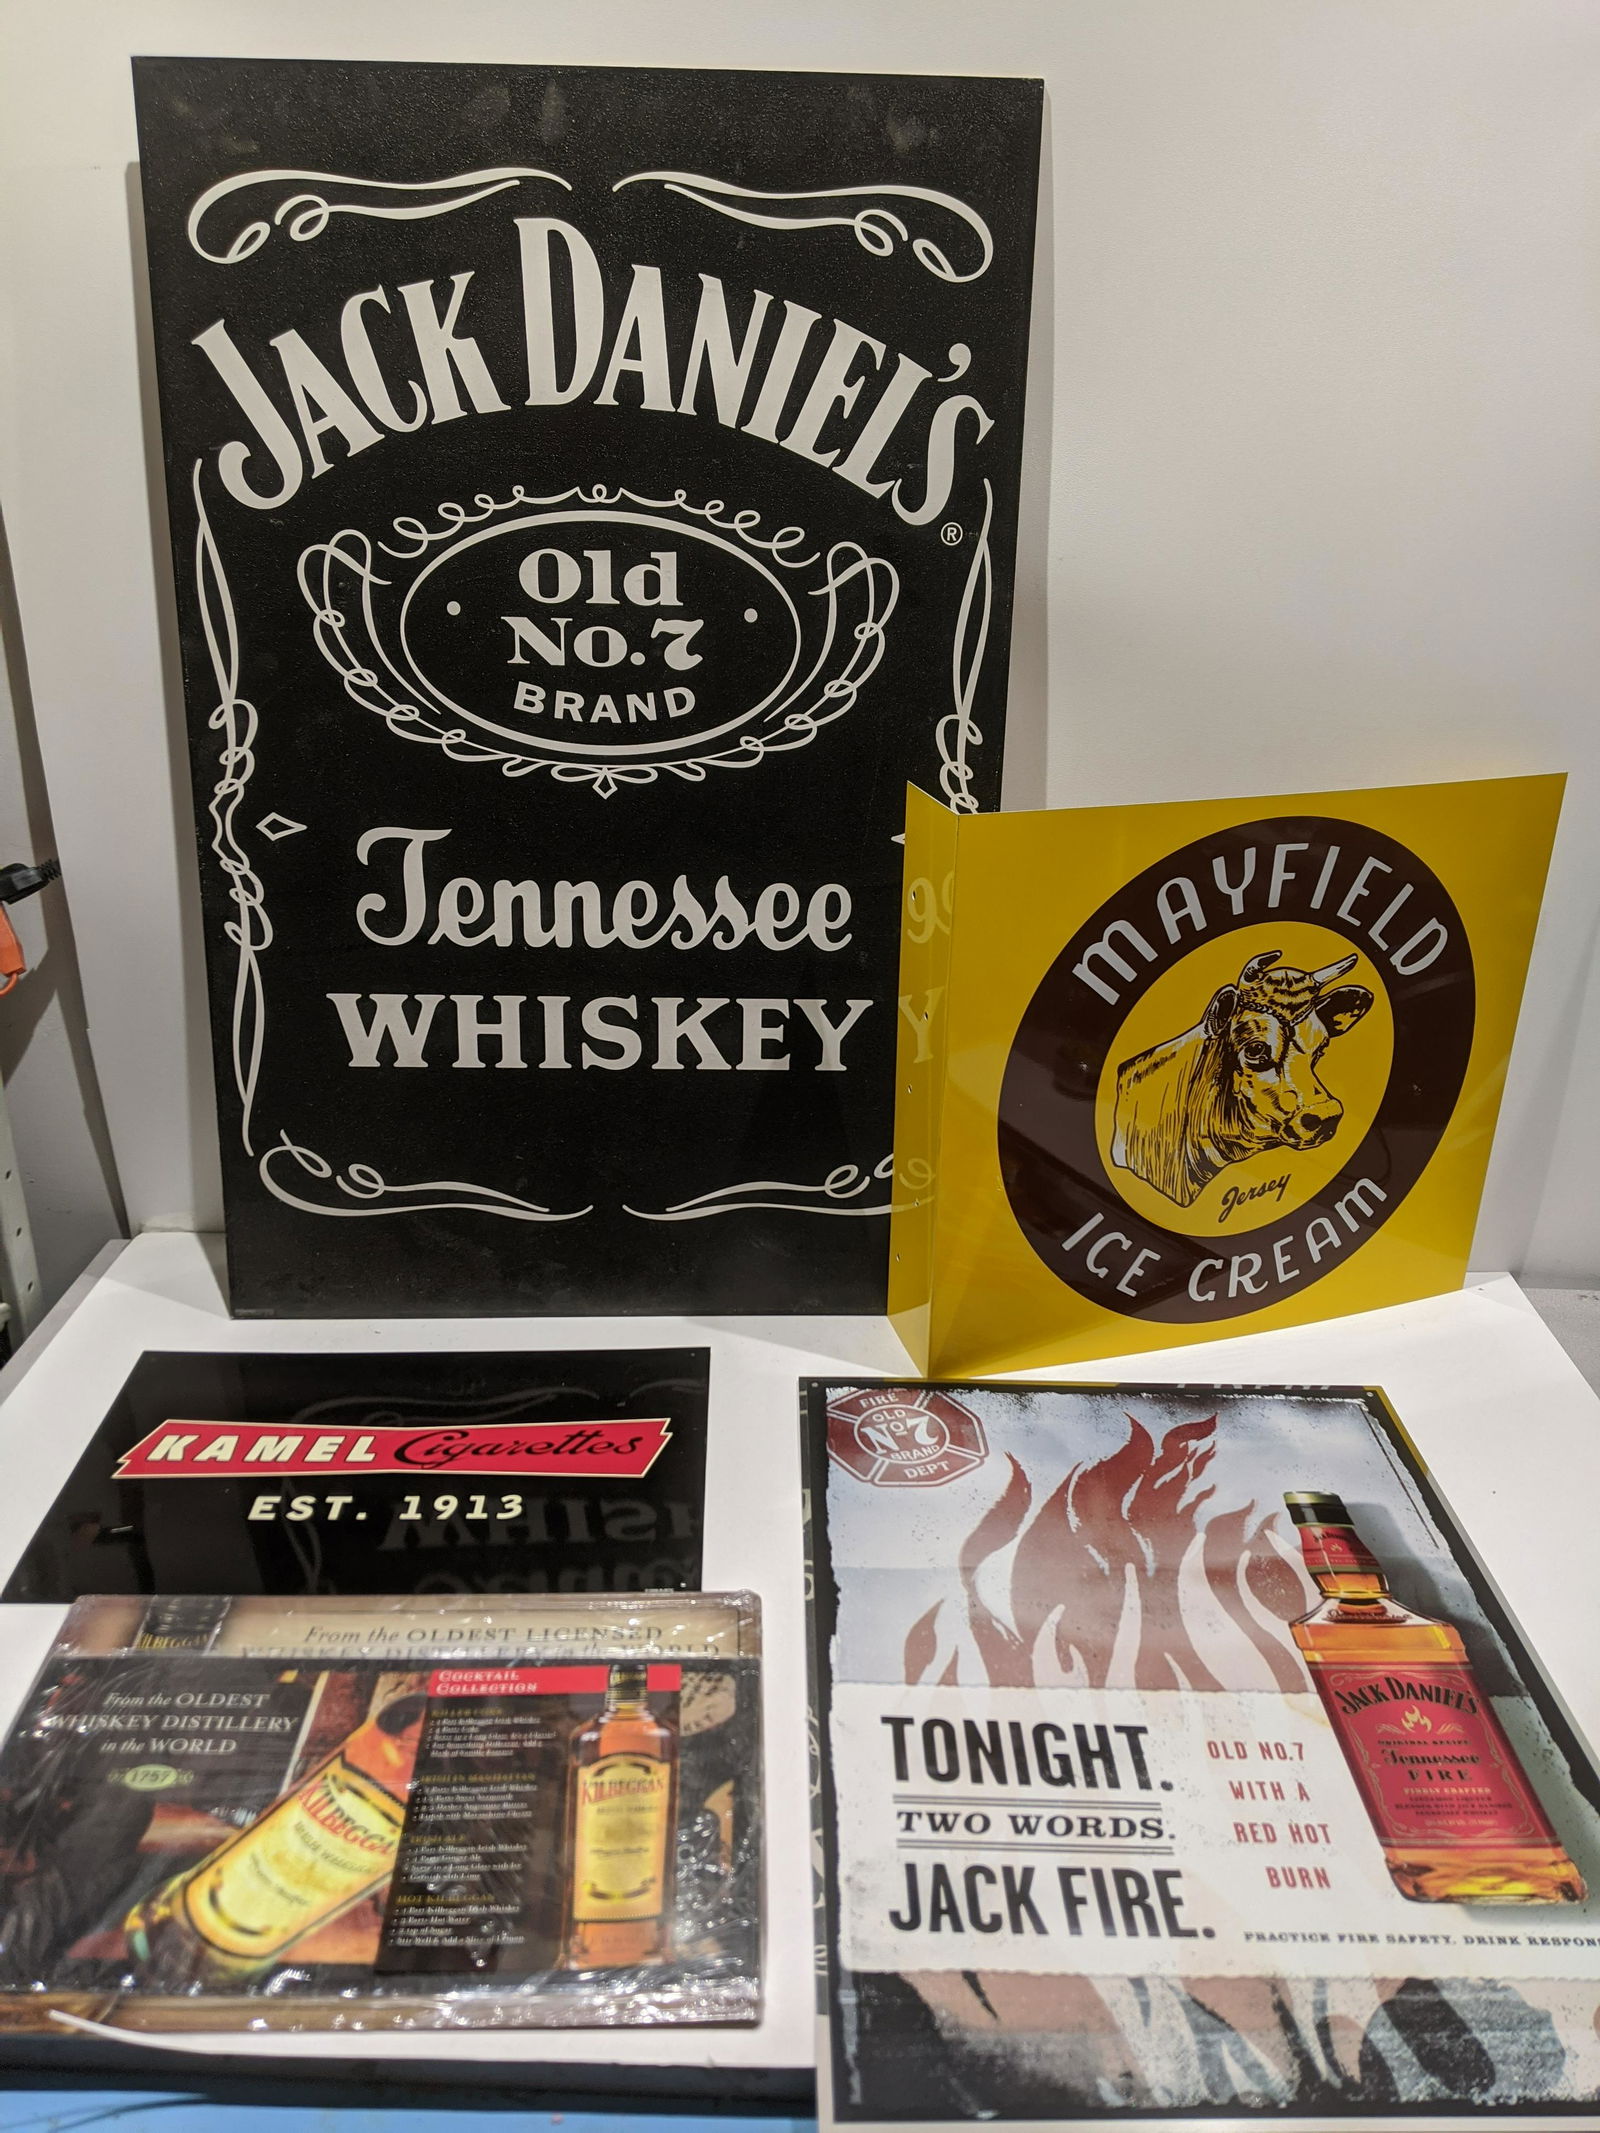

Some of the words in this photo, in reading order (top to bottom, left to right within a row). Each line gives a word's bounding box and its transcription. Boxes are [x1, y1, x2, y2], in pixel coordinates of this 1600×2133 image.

[191, 271, 511, 510] JACK
[513, 217, 994, 525] DANIEL'S
[519, 549, 679, 606] Old
[513, 681, 696, 725] BRAND
[356, 827, 852, 951] Tennessee
[1072, 842, 1449, 1005] MAYFIELD
[326, 993, 873, 1072] WHISKEY
[1218, 1172, 1294, 1223] Jersey
[1061, 1212, 1161, 1297] ICE
[1188, 1177, 1388, 1301] CREAM
[859, 1392, 899, 1408] FIRE
[872, 1409, 906, 1422] OLD
[145, 1434, 377, 1463] KAMEL
[393, 1430, 644, 1470] Cigarettes
[890, 1444, 940, 1460] BRAND
[904, 1460, 950, 1479] DEPT
[248, 1496, 367, 1522] EST.
[398, 1494, 525, 1521] 1913
[304, 1626, 360, 1644] From
[367, 1625, 399, 1643] the
[406, 1627, 516, 1642] OLDEST
[526, 1626, 662, 1642] LICENSED
[439, 1669, 519, 1682] COCKTAIL
[103, 1692, 145, 1708] From
[149, 1692, 172, 1707] the
[175, 1693, 270, 1708] OLDEST
[436, 1682, 538, 1696] COLLECTION
[1333, 1681, 1391, 1715] JACK
[1384, 1676, 1480, 1714] DANIEL'S
[51, 1714, 159, 1731] WHISKEY
[161, 1715, 298, 1732] DISTILLERY
[100, 1739, 118, 1753] in
[120, 1738, 145, 1753] the
[149, 1738, 238, 1754] WORLD
[880, 1716, 1174, 1792] TONIGHT.
[1207, 1740, 1248, 1760] OLD
[1258, 1741, 1304, 1761] NO.7
[1381, 1748, 1481, 1765] Tennessee
[1408, 1769, 1473, 1781] FIRE
[1228, 1780, 1285, 1801] WITH
[1297, 1781, 1311, 1802] A
[300, 1773, 397, 1855] KILBEGGA
[897, 1811, 990, 1833] TWO
[1008, 1814, 1175, 1840] WORDS.
[1233, 1822, 1278, 1844] RED
[1288, 1822, 1331, 1844] HOT
[1265, 1866, 1331, 1889] BURN
[889, 1863, 1048, 1935] JACK
[1057, 1867, 1216, 1939] FIRE.
[1243, 1930, 1330, 1943] PRACTICE
[1337, 1932, 1380, 1944] FIRE
[1386, 1933, 1456, 1945] SAFETY.
[1462, 1934, 1521, 1946] DRINK
